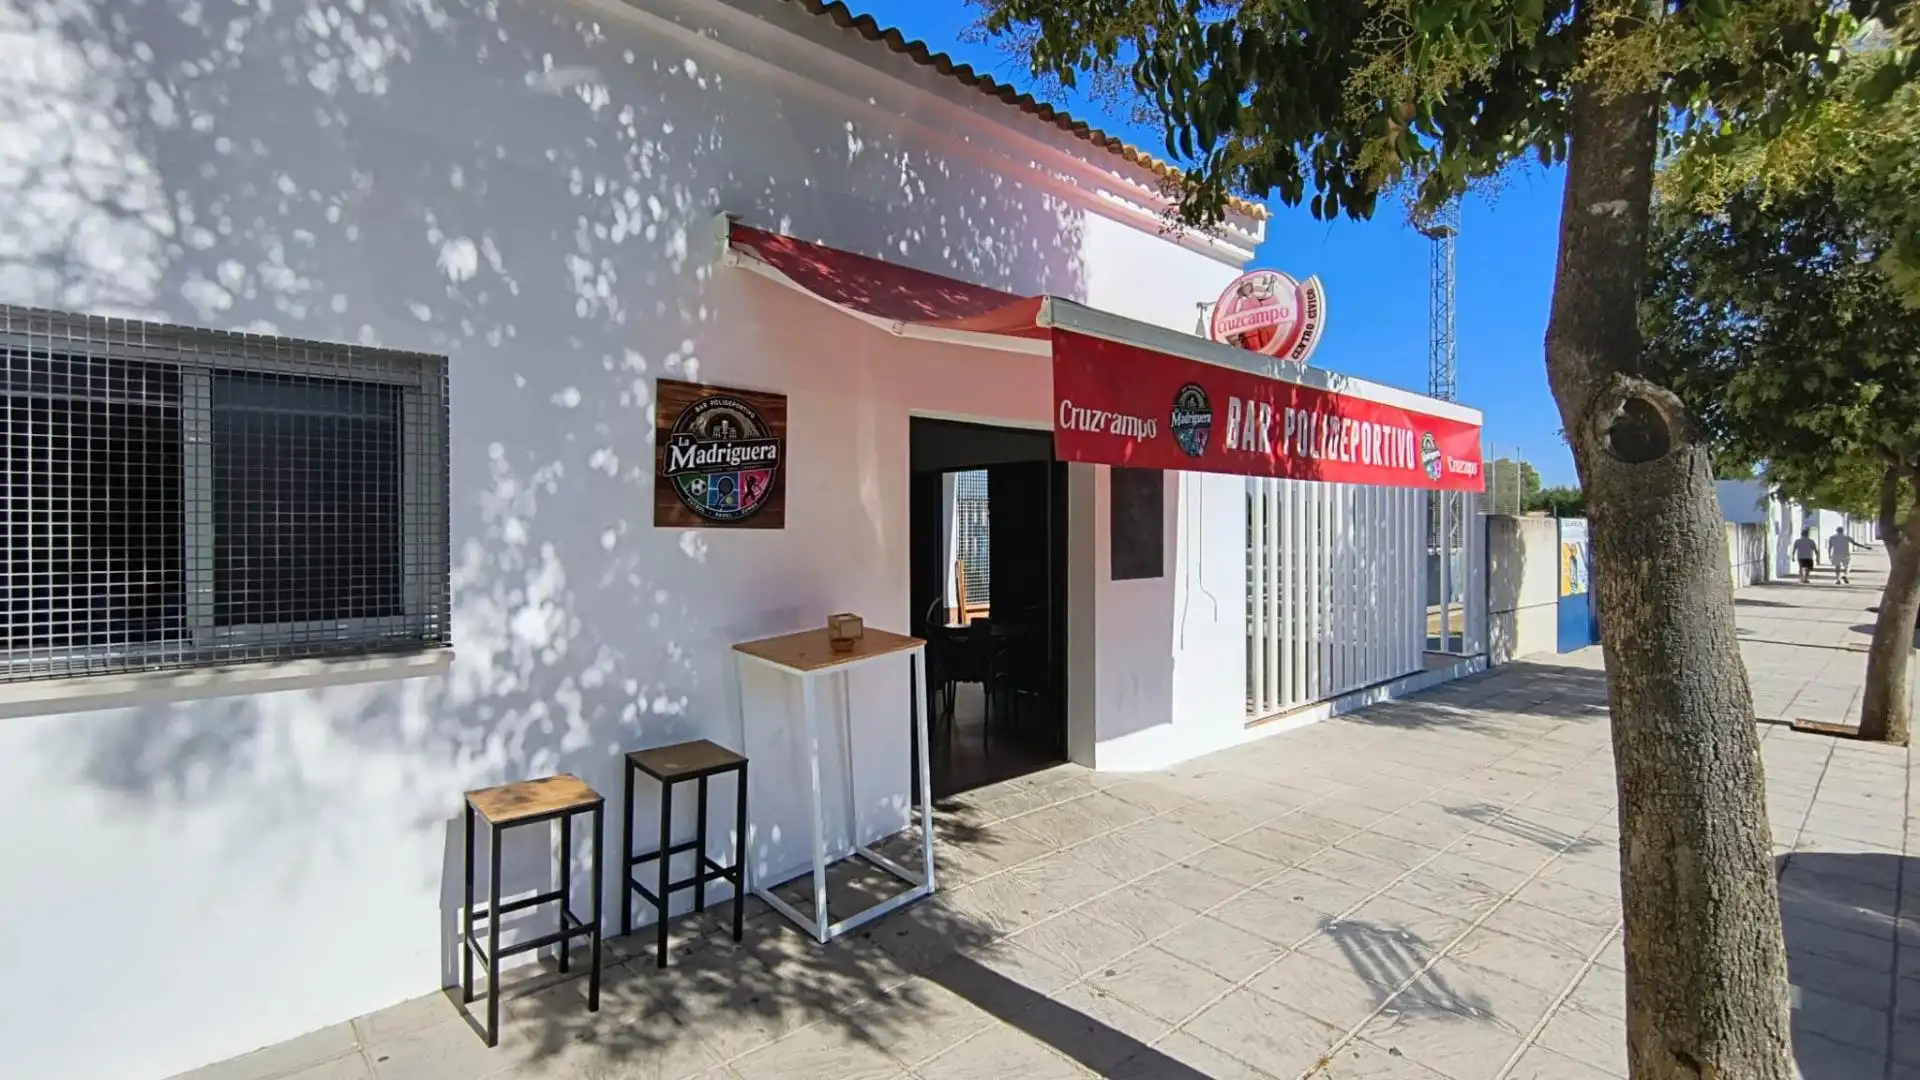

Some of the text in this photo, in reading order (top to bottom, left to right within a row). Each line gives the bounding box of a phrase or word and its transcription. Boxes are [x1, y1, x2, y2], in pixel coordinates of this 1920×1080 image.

[1217, 306, 1290, 334] Cruzcampo
[1291, 324, 1314, 360] CENTRO
[695, 399, 755, 419] BAR POLIDEPORTIVO
[1060, 399, 1157, 443] Cruzcampo
[678, 436, 690, 447] La
[1226, 395, 1416, 470] BAR POLIDEPORTIVO
[669, 442, 777, 473] Madriguera
